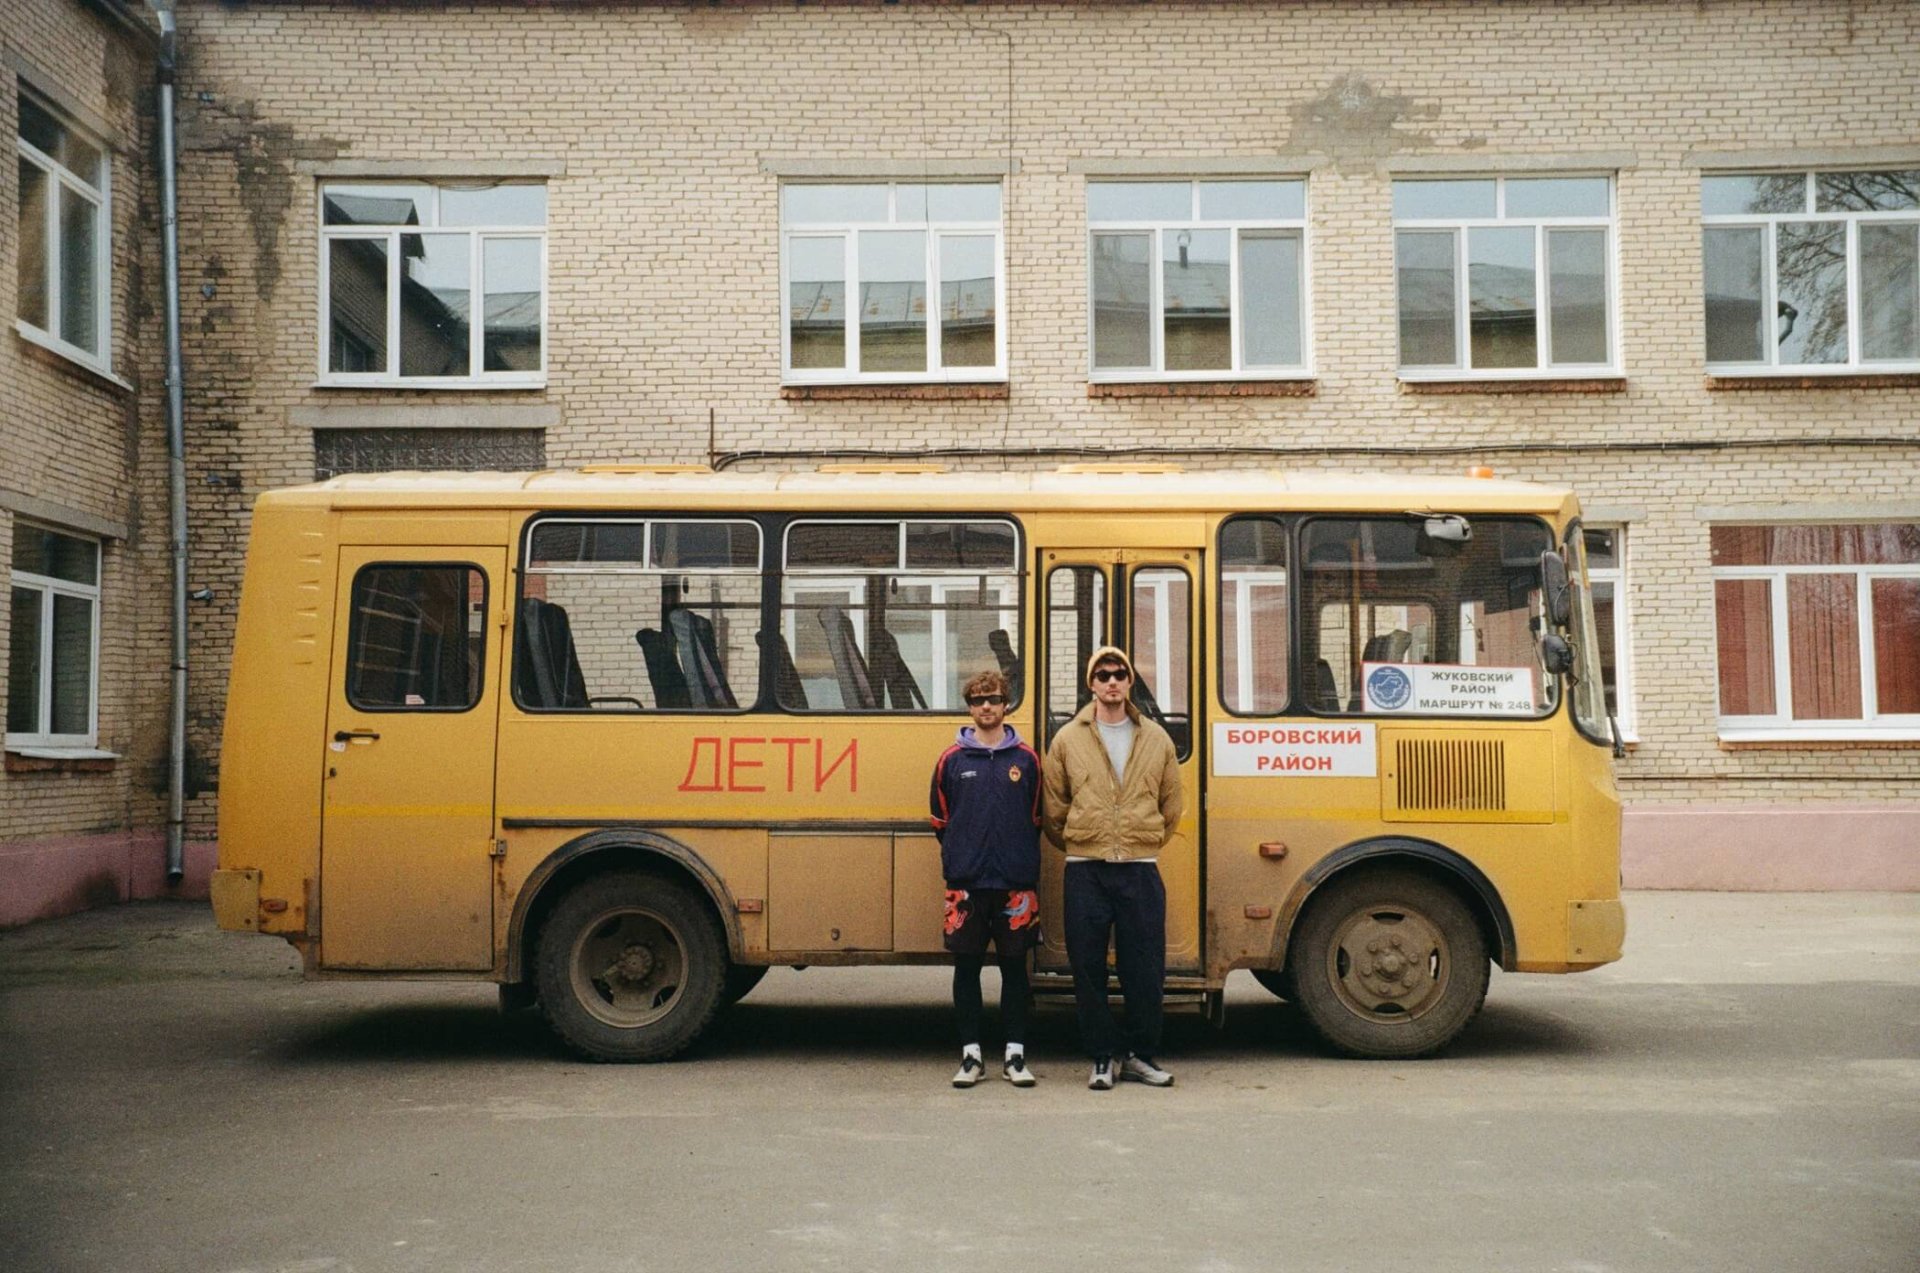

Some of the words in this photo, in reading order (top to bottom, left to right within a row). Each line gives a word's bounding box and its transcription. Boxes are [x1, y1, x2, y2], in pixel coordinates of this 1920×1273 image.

[1431, 671, 1514, 682] ЖУКОВСКИЙ
[1451, 683, 1496, 694] РАЙОН
[1419, 699, 1485, 709] МАРШРУТ
[1508, 701, 1532, 710] 248
[1227, 727, 1362, 744] БОРОВСКИЙ
[677, 737, 858, 792] ДЕТИ
[1257, 753, 1332, 770] РАЙОН
